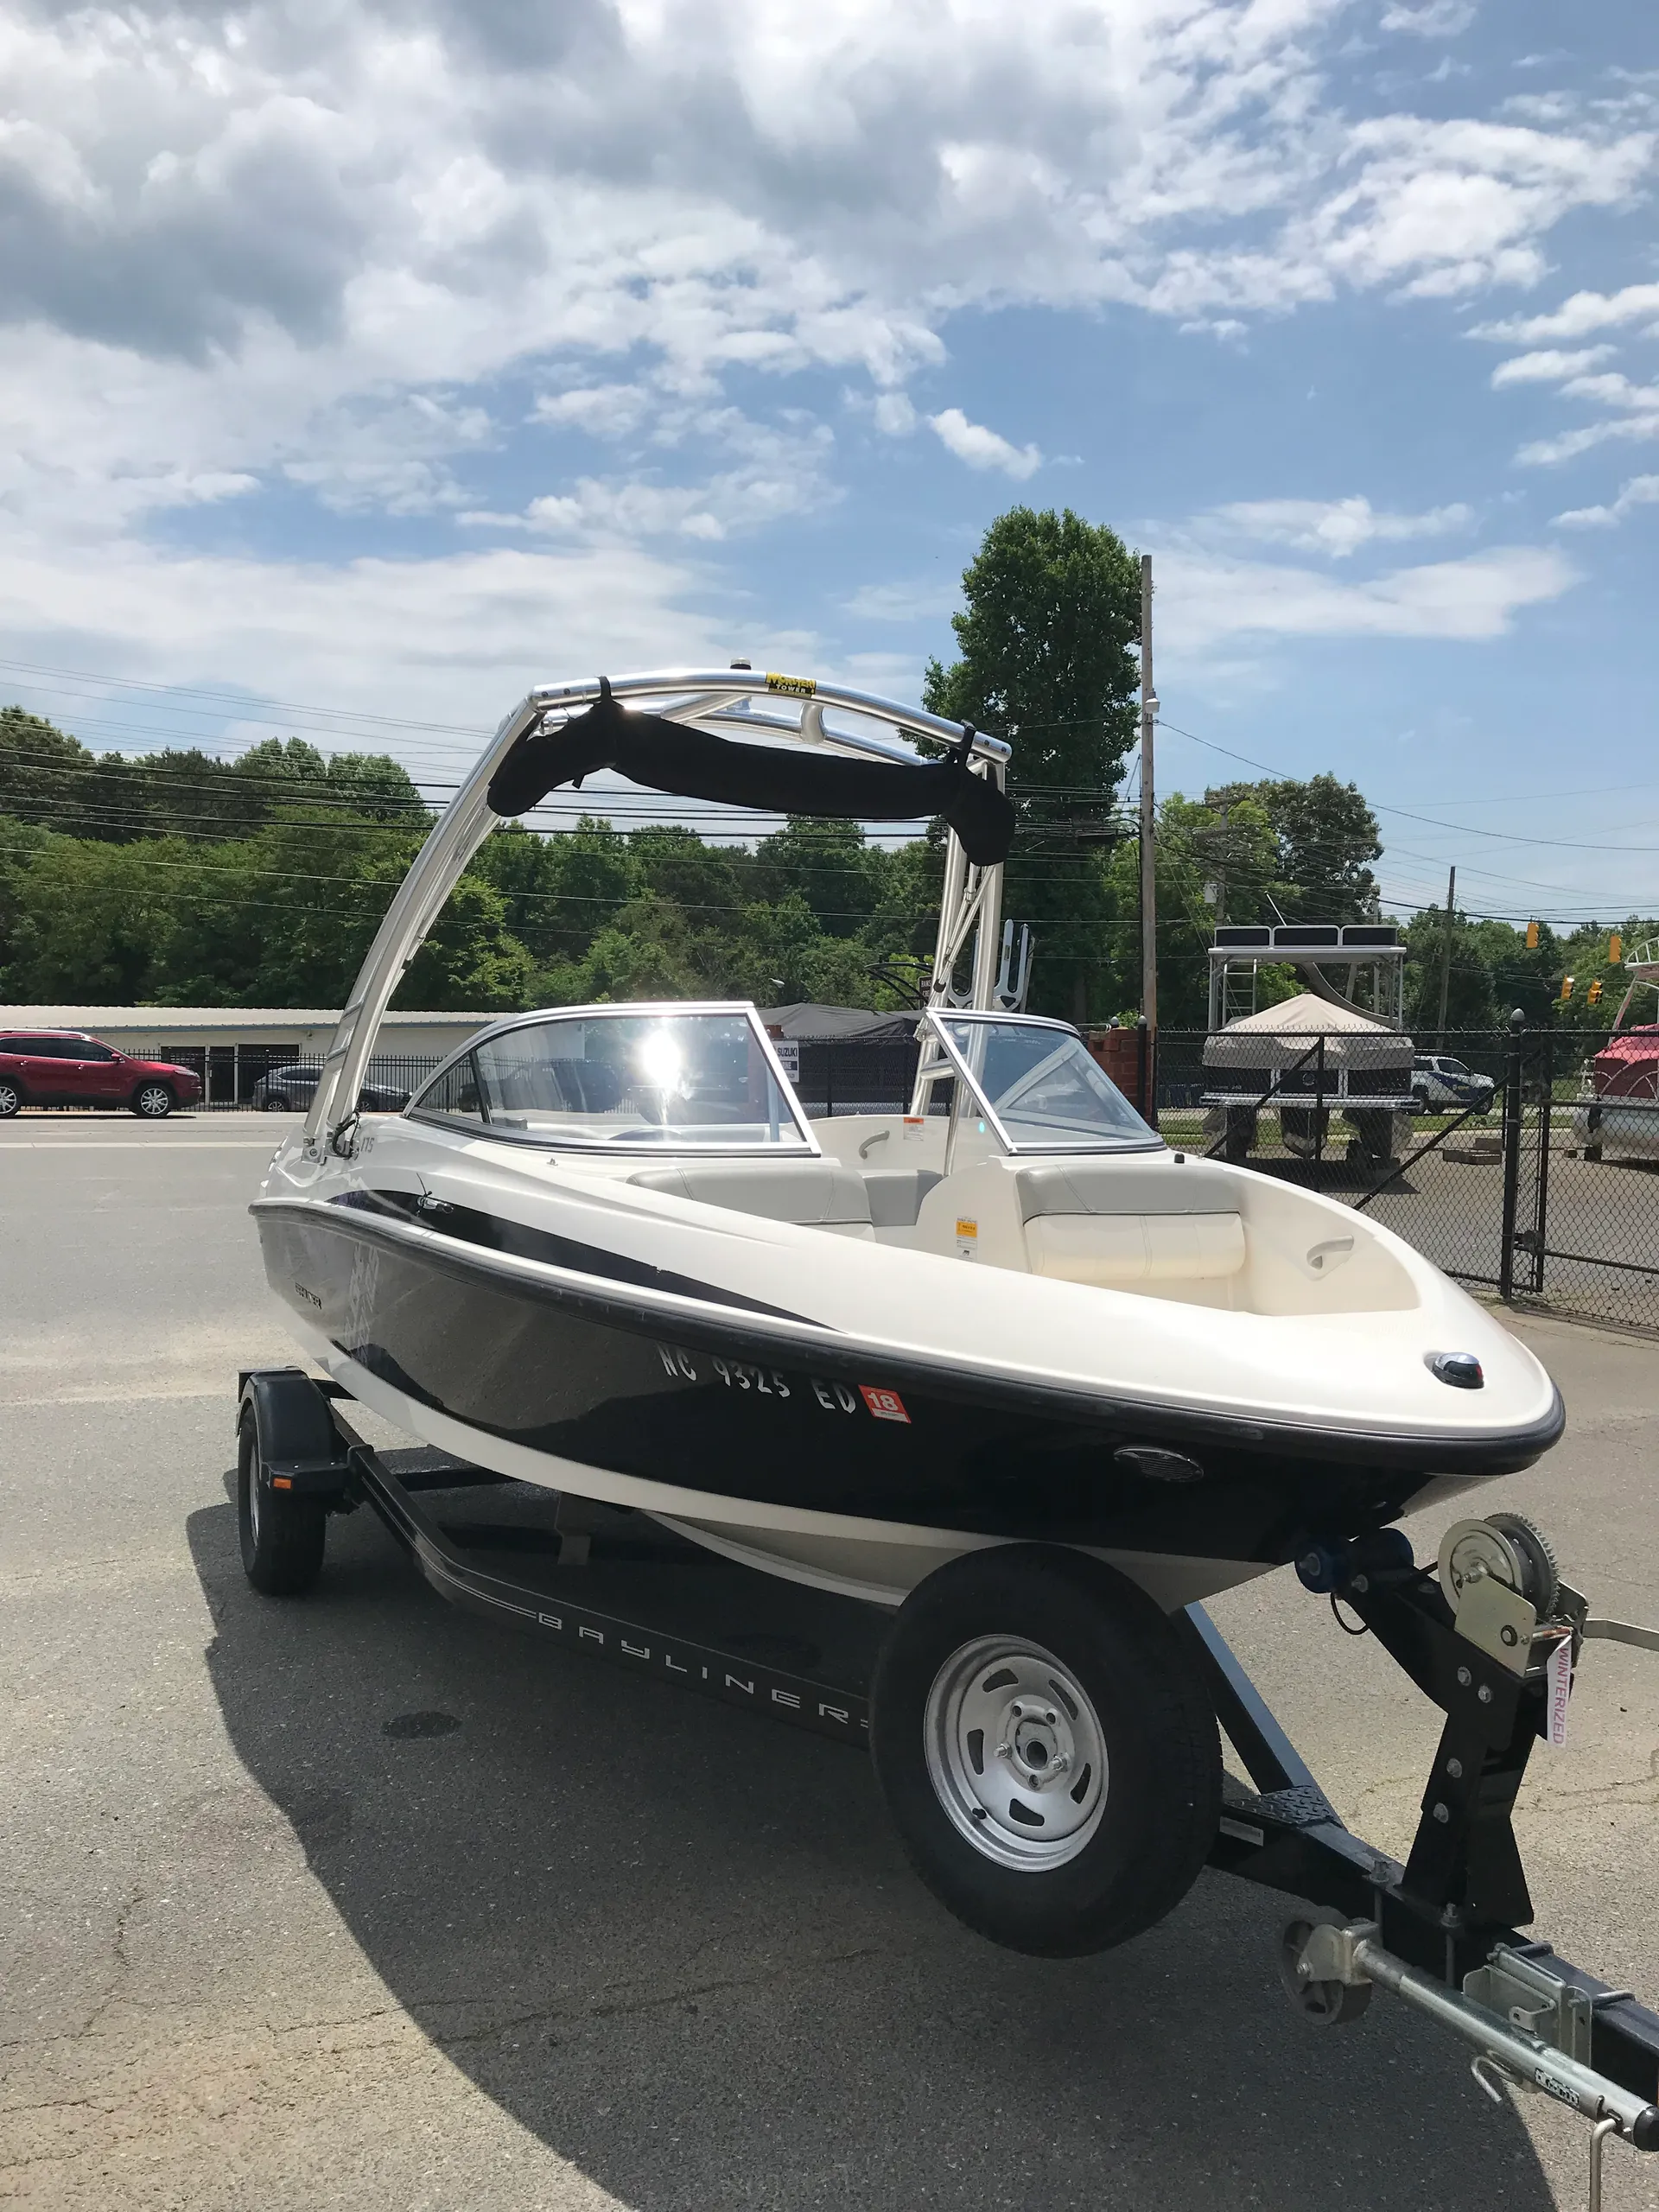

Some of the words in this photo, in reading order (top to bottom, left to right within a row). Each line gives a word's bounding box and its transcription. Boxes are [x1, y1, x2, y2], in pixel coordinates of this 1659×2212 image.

[776, 684, 806, 694] TOWER
[778, 1047, 798, 1058] SUZUKI
[657, 1340, 697, 1381] NC
[710, 1356, 791, 1398] 9325
[810, 1378, 856, 1414] ED
[867, 1392, 899, 1411] 18
[538, 1611, 849, 1724] BAYLINER
[1553, 1647, 1569, 1745] WINTERIZED
